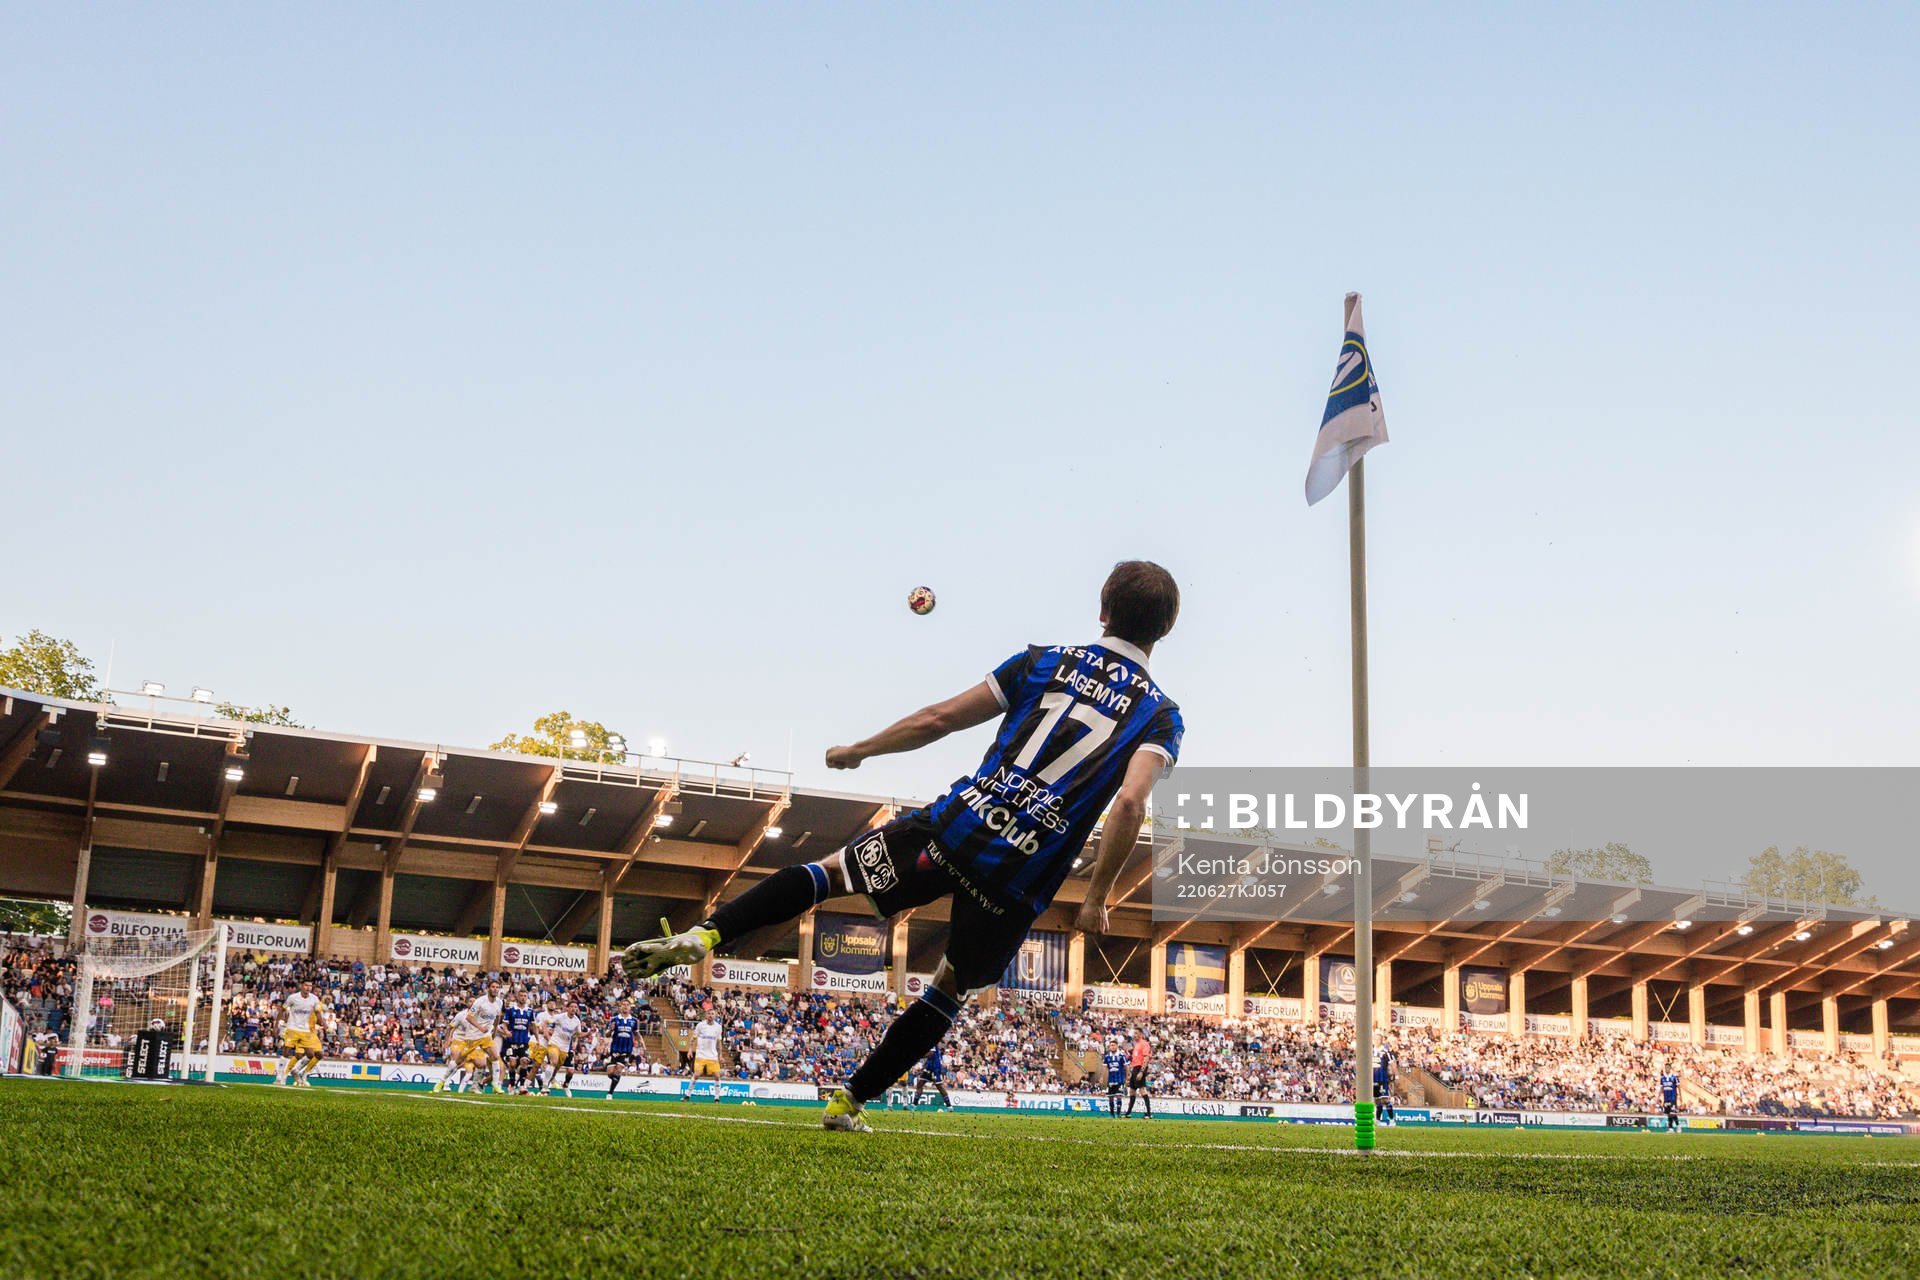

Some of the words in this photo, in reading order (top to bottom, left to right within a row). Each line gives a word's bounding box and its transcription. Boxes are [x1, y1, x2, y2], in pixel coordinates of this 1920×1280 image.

[1054, 664, 1132, 714] LAGEMYR
[1131, 673, 1162, 702] TAK
[1013, 692, 1118, 785] 17
[994, 766, 1064, 811] NORDIC
[977, 773, 1070, 834] WELLNESS
[111, 923, 184, 939] BILFORUM
[236, 933, 307, 949] BILFORUM
[841, 935, 877, 947] Uppsala
[414, 946, 479, 961] BILFORUM
[840, 946, 880, 956] kommun
[522, 954, 586, 969] BILFORUM
[729, 970, 786, 984] BILFORUM
[830, 977, 886, 990] BILFORUM
[1015, 989, 1064, 1002] BILFORUM
[1097, 995, 1146, 1008] BILFORUM
[1178, 1000, 1224, 1012] BILFORUM
[1255, 1005, 1300, 1017] BILFORUM
[1399, 1015, 1440, 1026] BILFORUM
[1467, 1018, 1506, 1029] BILFORUM
[1531, 1022, 1568, 1034] BILFORUM
[1654, 1029, 1688, 1040] BILFORUM
[138, 1038, 150, 1074] SELECT
[157, 1040, 168, 1075] SELECT
